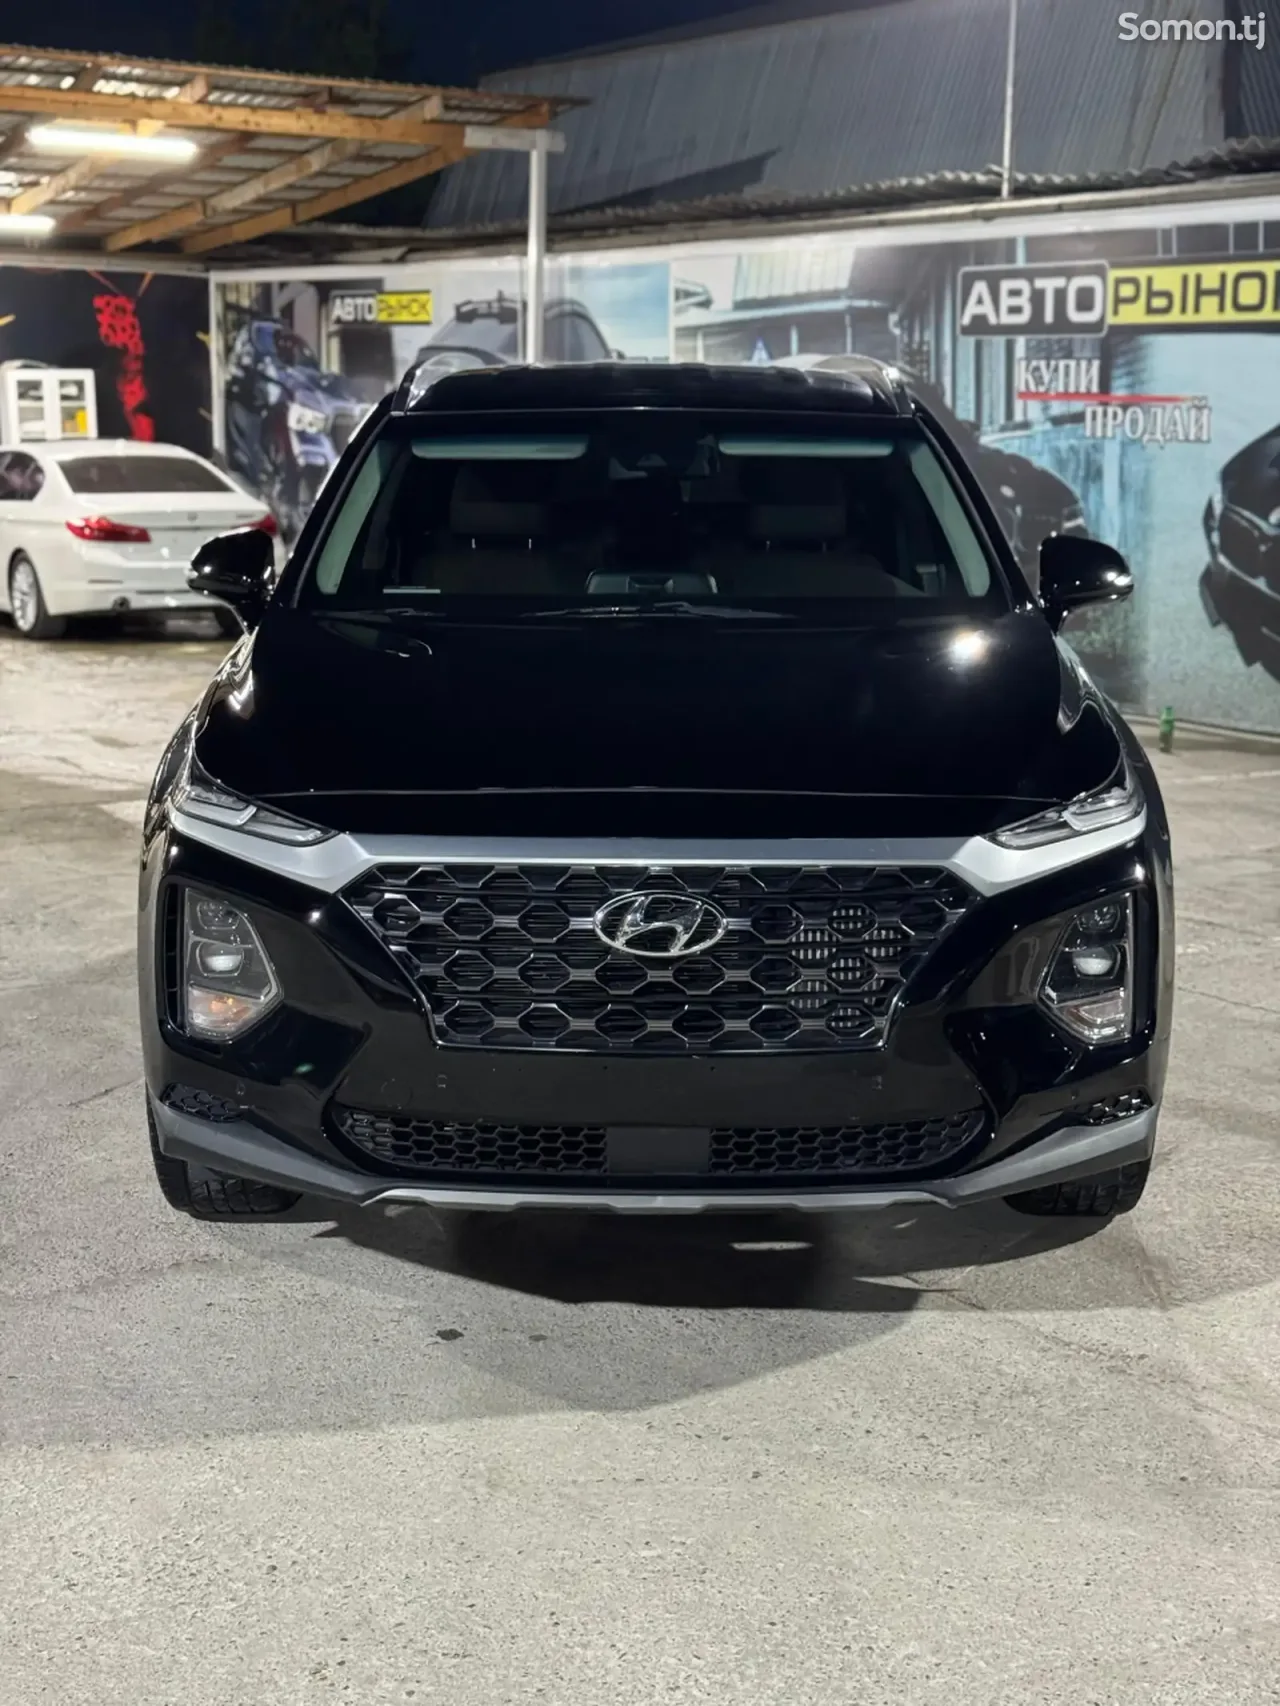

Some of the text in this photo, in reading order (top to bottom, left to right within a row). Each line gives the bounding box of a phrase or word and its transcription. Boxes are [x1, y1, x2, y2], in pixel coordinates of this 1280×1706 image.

[961, 271, 1280, 325] АВТОРЫНО
[1018, 358, 1101, 393] КУПИ
[1084, 396, 1212, 450] ПРОДАЙ
